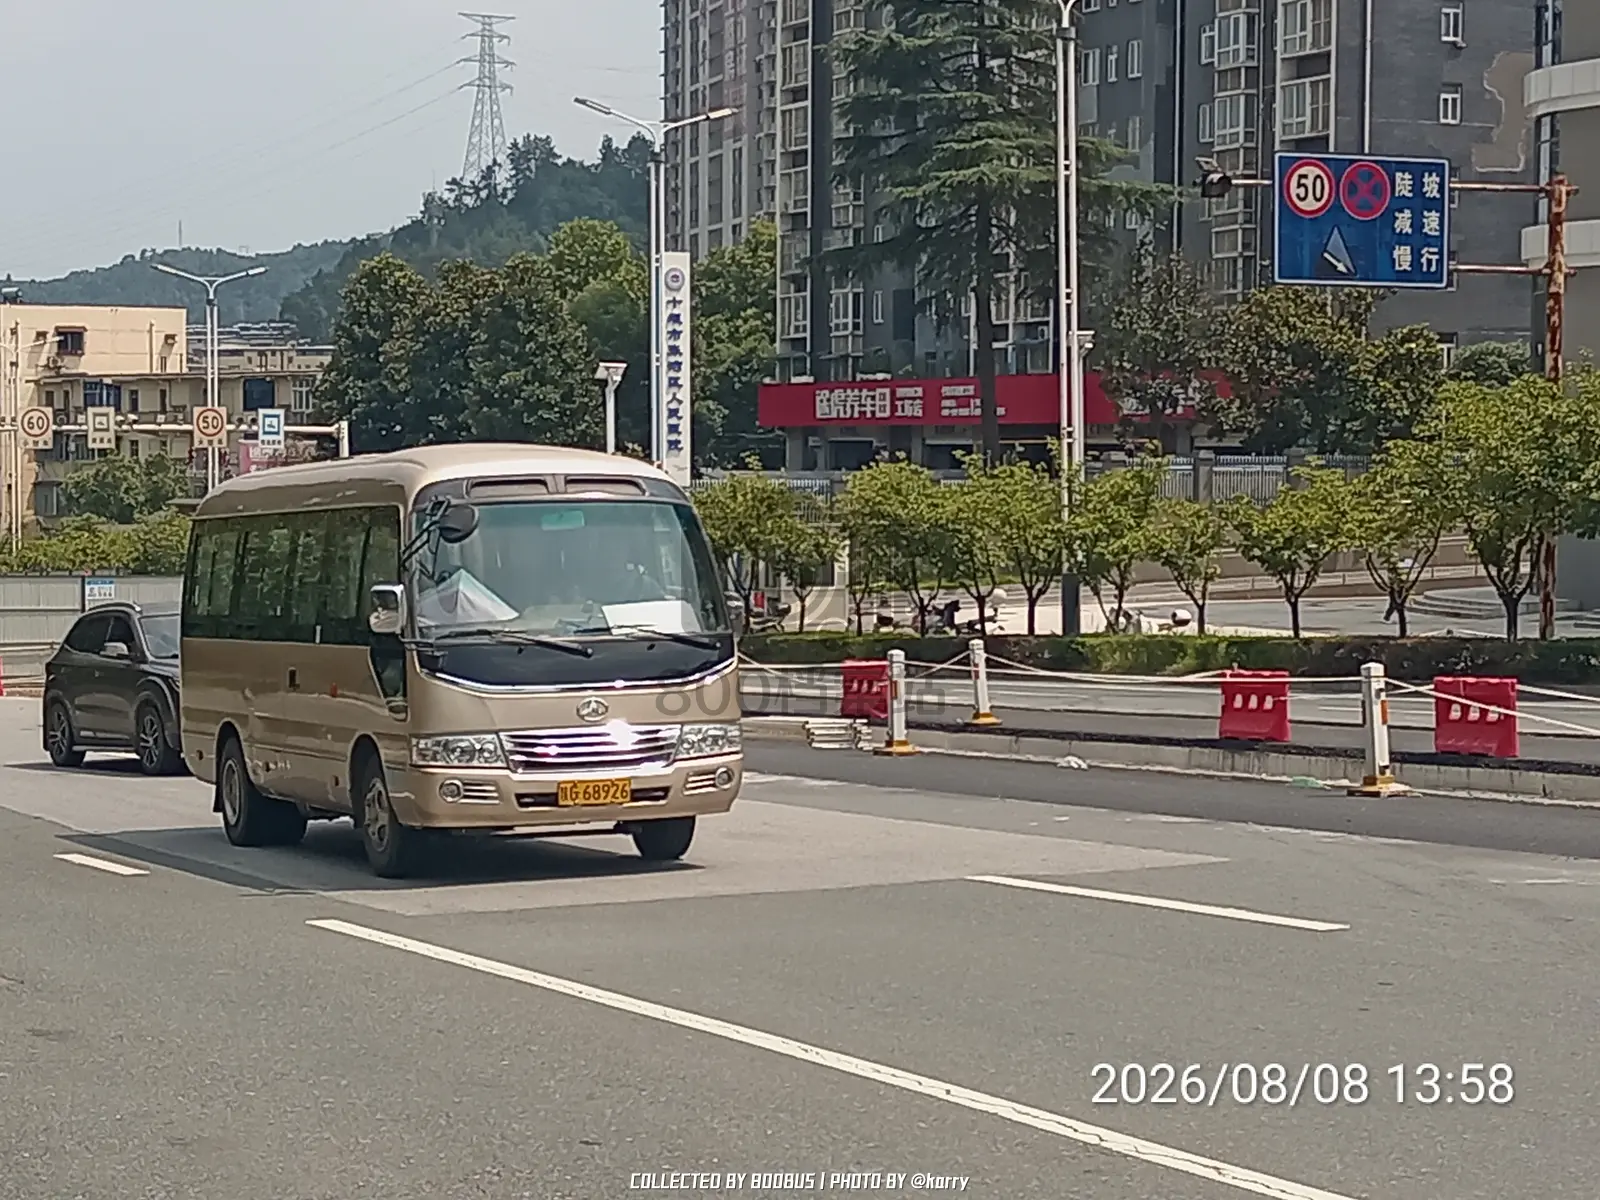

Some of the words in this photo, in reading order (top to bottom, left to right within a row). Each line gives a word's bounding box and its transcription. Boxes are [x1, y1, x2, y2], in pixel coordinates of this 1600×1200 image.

[1296, 174, 1325, 202] 50
[1395, 172, 1440, 198] 陡坡
[1394, 208, 1440, 236] 减速
[1393, 245, 1439, 272] 慢行
[27, 416, 45, 430] 60
[202, 416, 219, 430] 50
